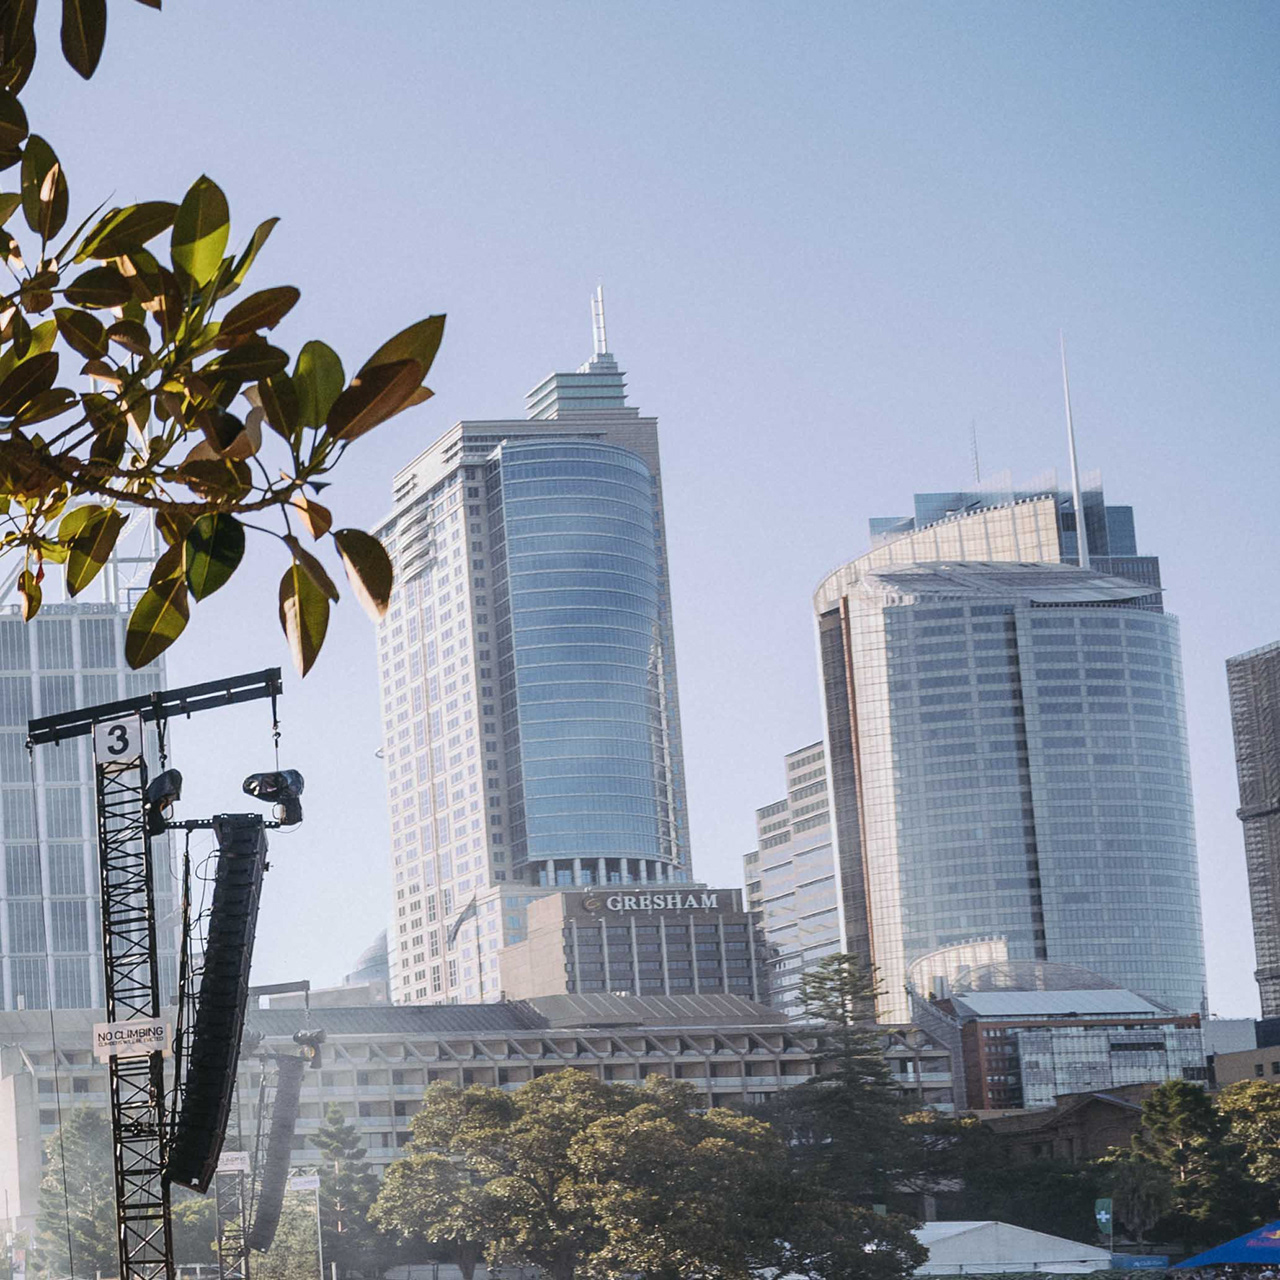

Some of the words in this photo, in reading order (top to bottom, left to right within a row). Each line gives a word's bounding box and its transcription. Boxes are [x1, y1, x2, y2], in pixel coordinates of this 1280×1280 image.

[107, 724, 129, 755] 3
[606, 894, 719, 911] GRESHAM
[98, 1032, 113, 1042] NO
[114, 1026, 164, 1040] CLIMBING
